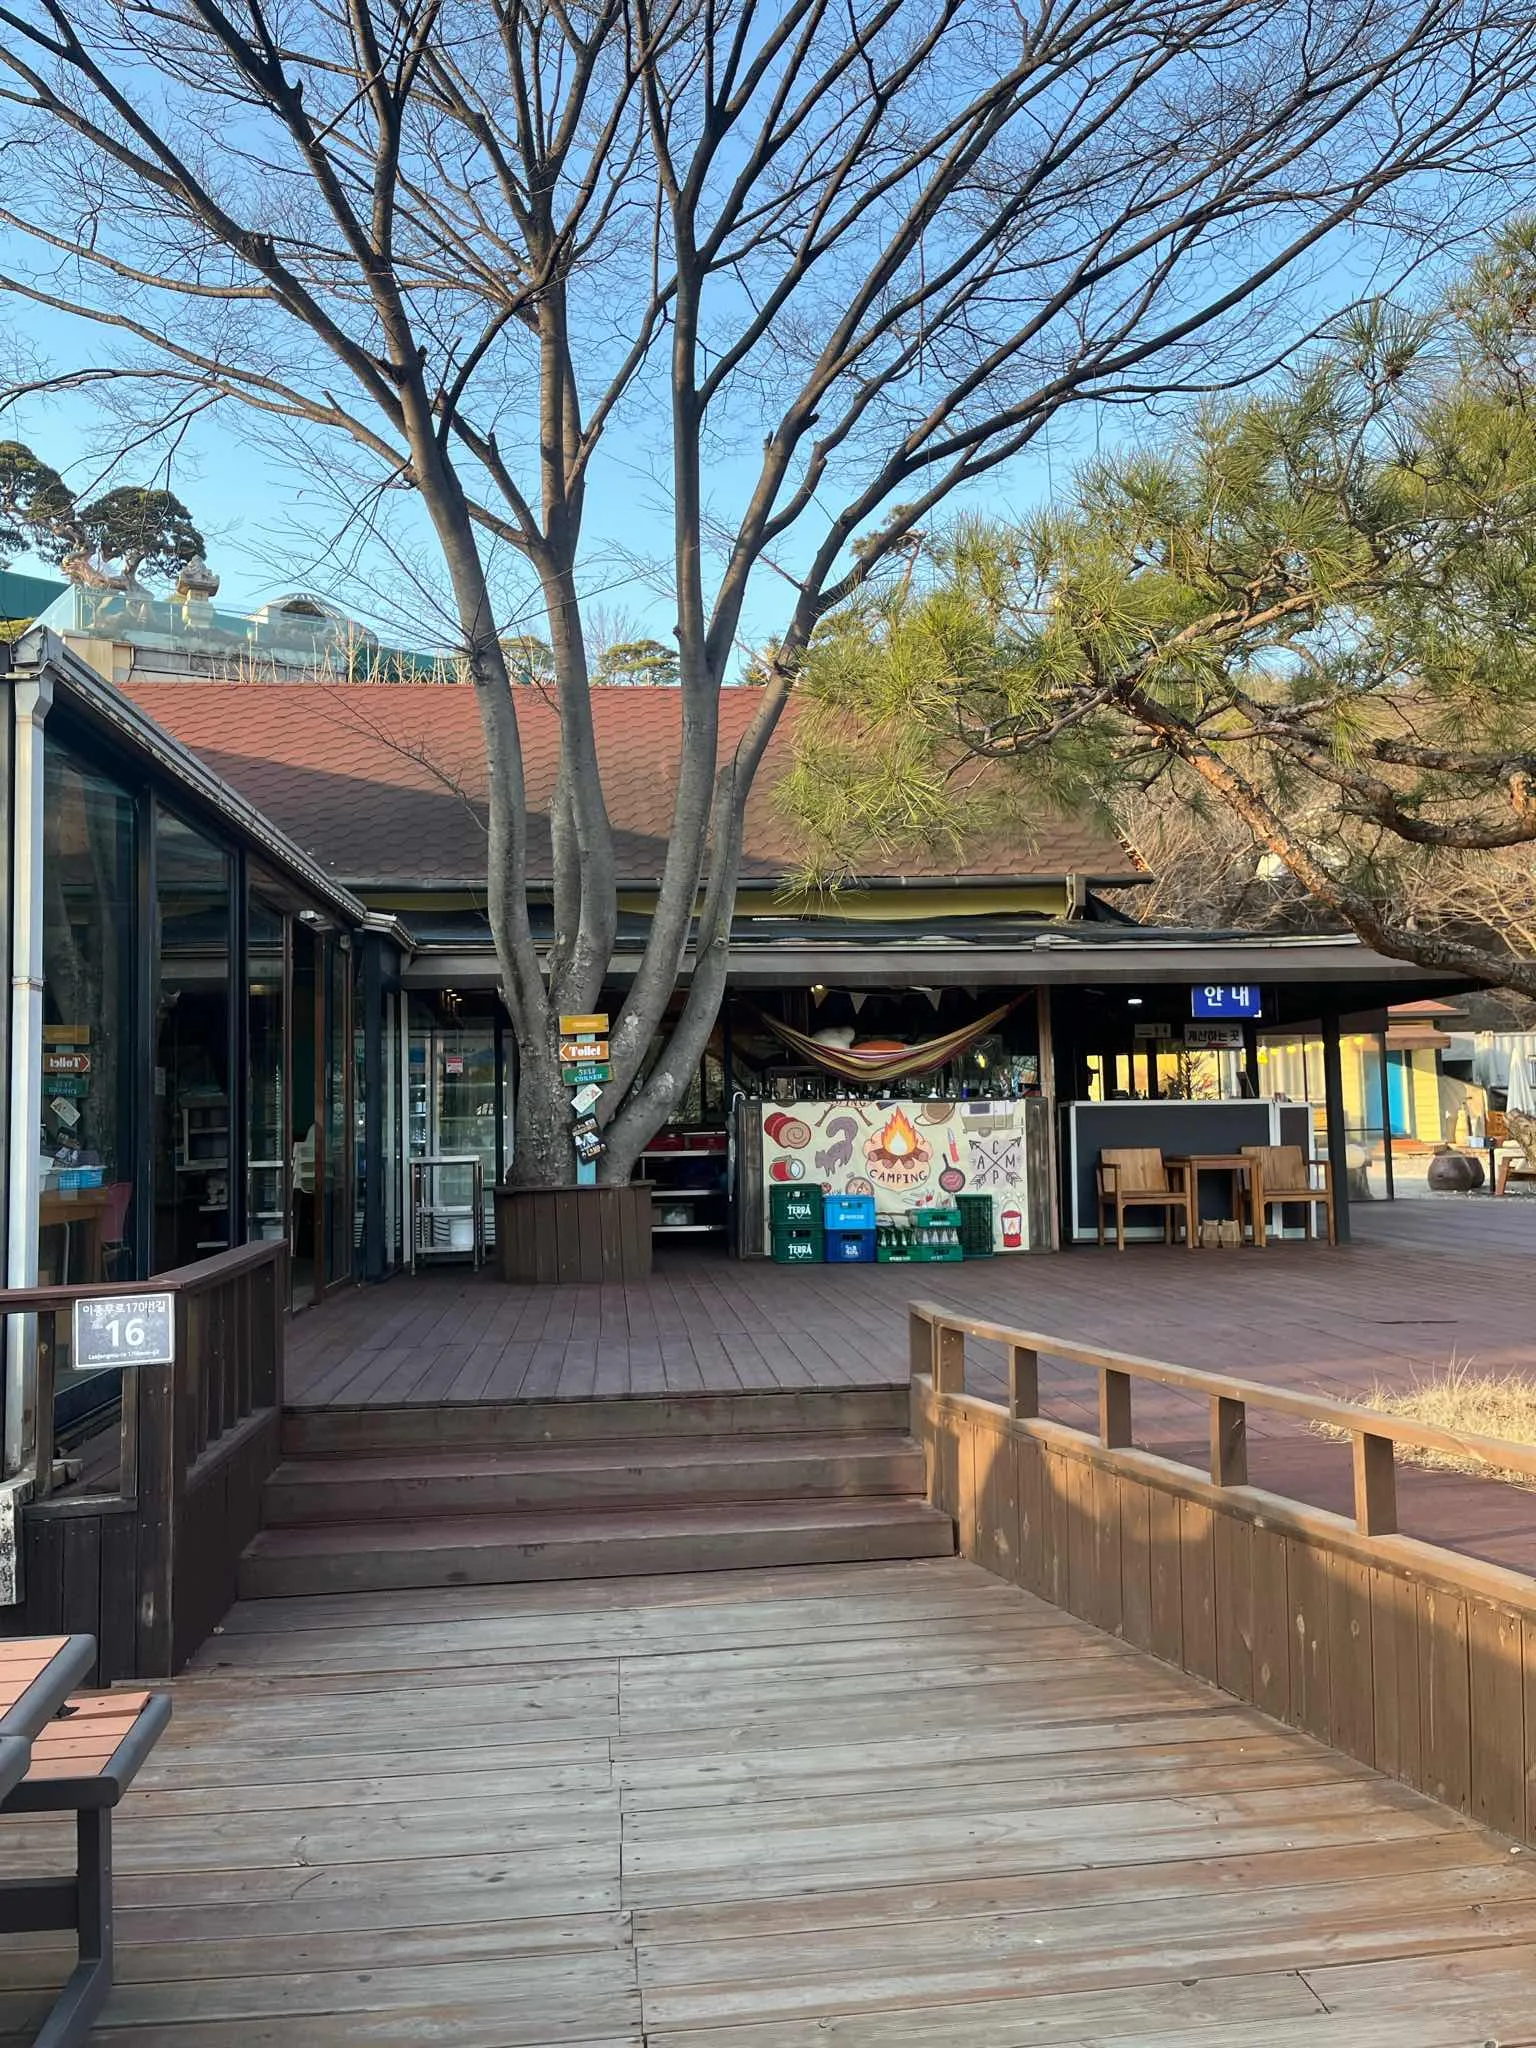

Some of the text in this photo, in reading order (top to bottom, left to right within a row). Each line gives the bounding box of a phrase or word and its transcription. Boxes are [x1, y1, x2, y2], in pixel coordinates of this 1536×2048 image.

[569, 1045, 601, 1057] Toilet
[869, 1169, 928, 1184] CAMPING
[787, 1203, 812, 1216] TERRA
[788, 1242, 813, 1256] TERRA
[105, 1318, 145, 1347] 16
